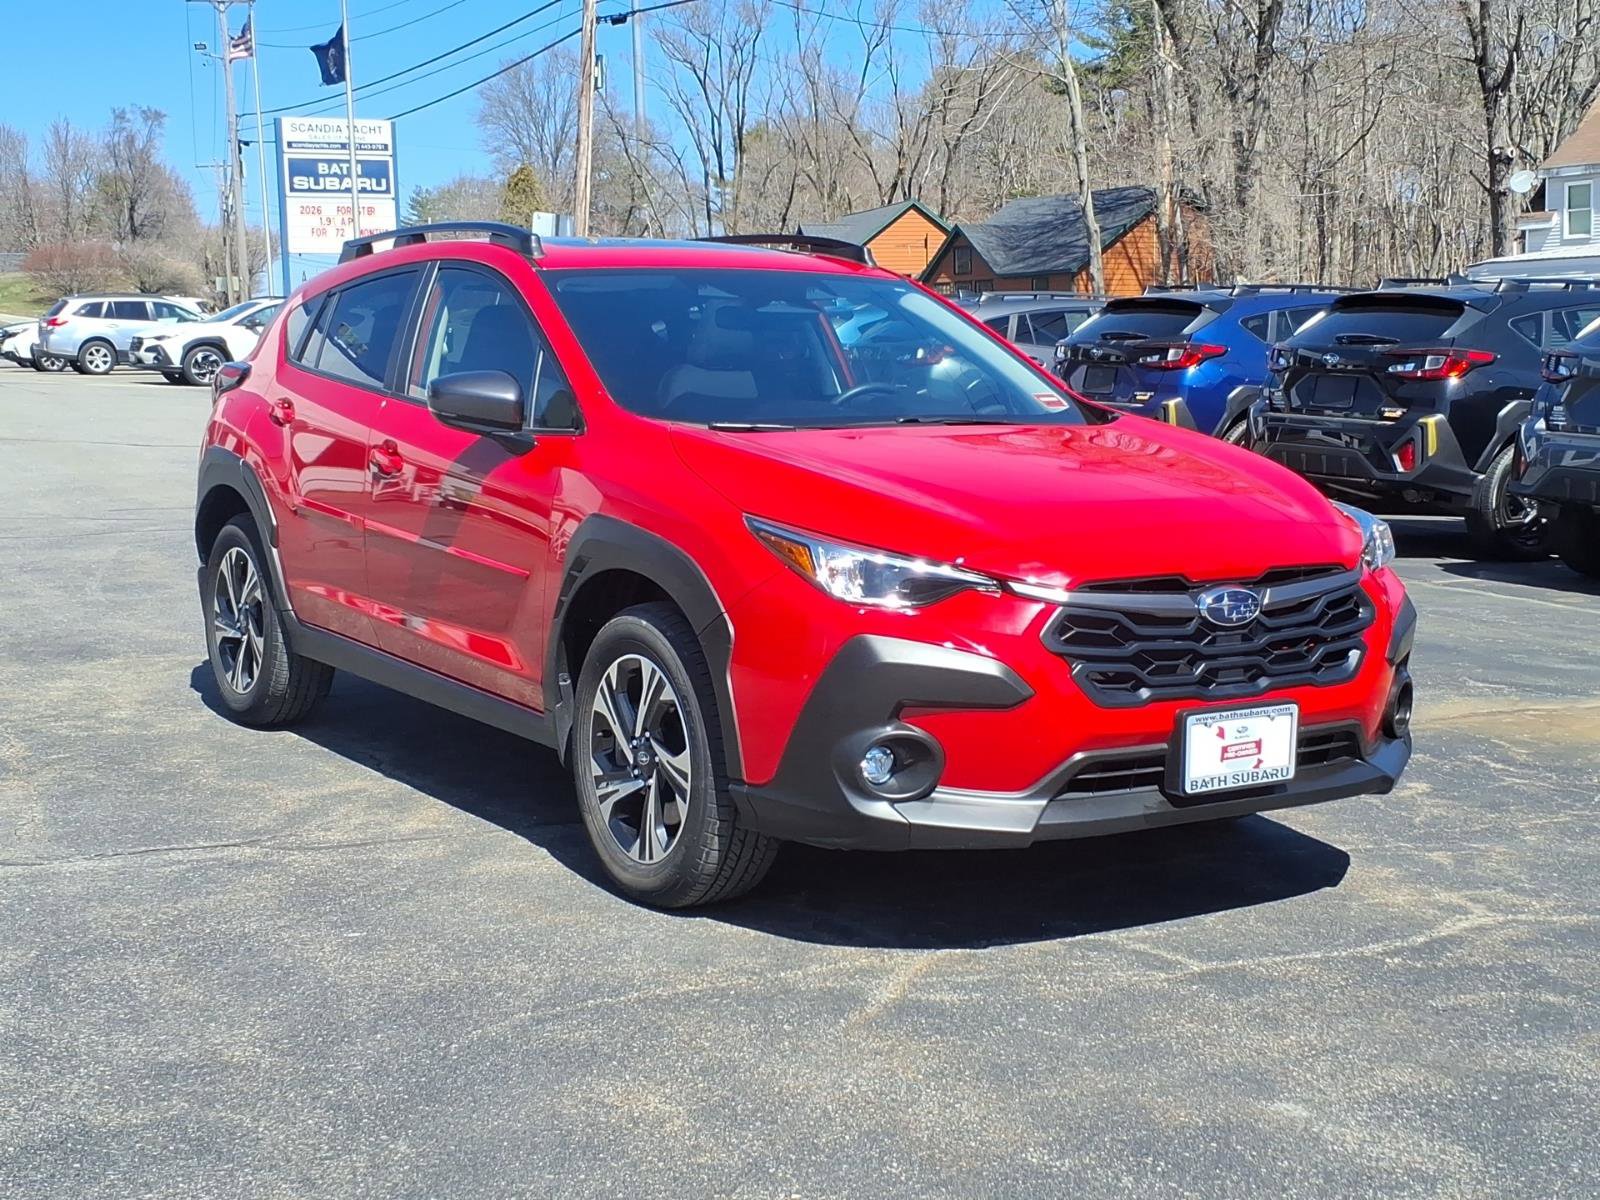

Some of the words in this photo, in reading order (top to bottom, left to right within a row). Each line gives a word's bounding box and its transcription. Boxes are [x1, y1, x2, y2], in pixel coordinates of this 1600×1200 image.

[290, 123, 342, 133] SCANDIA
[293, 176, 387, 191] SUBARU
[299, 205, 322, 215] 2026
[336, 206, 376, 216] FORSTER
[341, 217, 356, 226] AP
[311, 227, 328, 237] FOR
[335, 227, 346, 237] 72
[1194, 706, 1291, 722] www.bathsubaru.com
[1190, 775, 1228, 791] BATH
[1231, 767, 1290, 785] SUBARU
